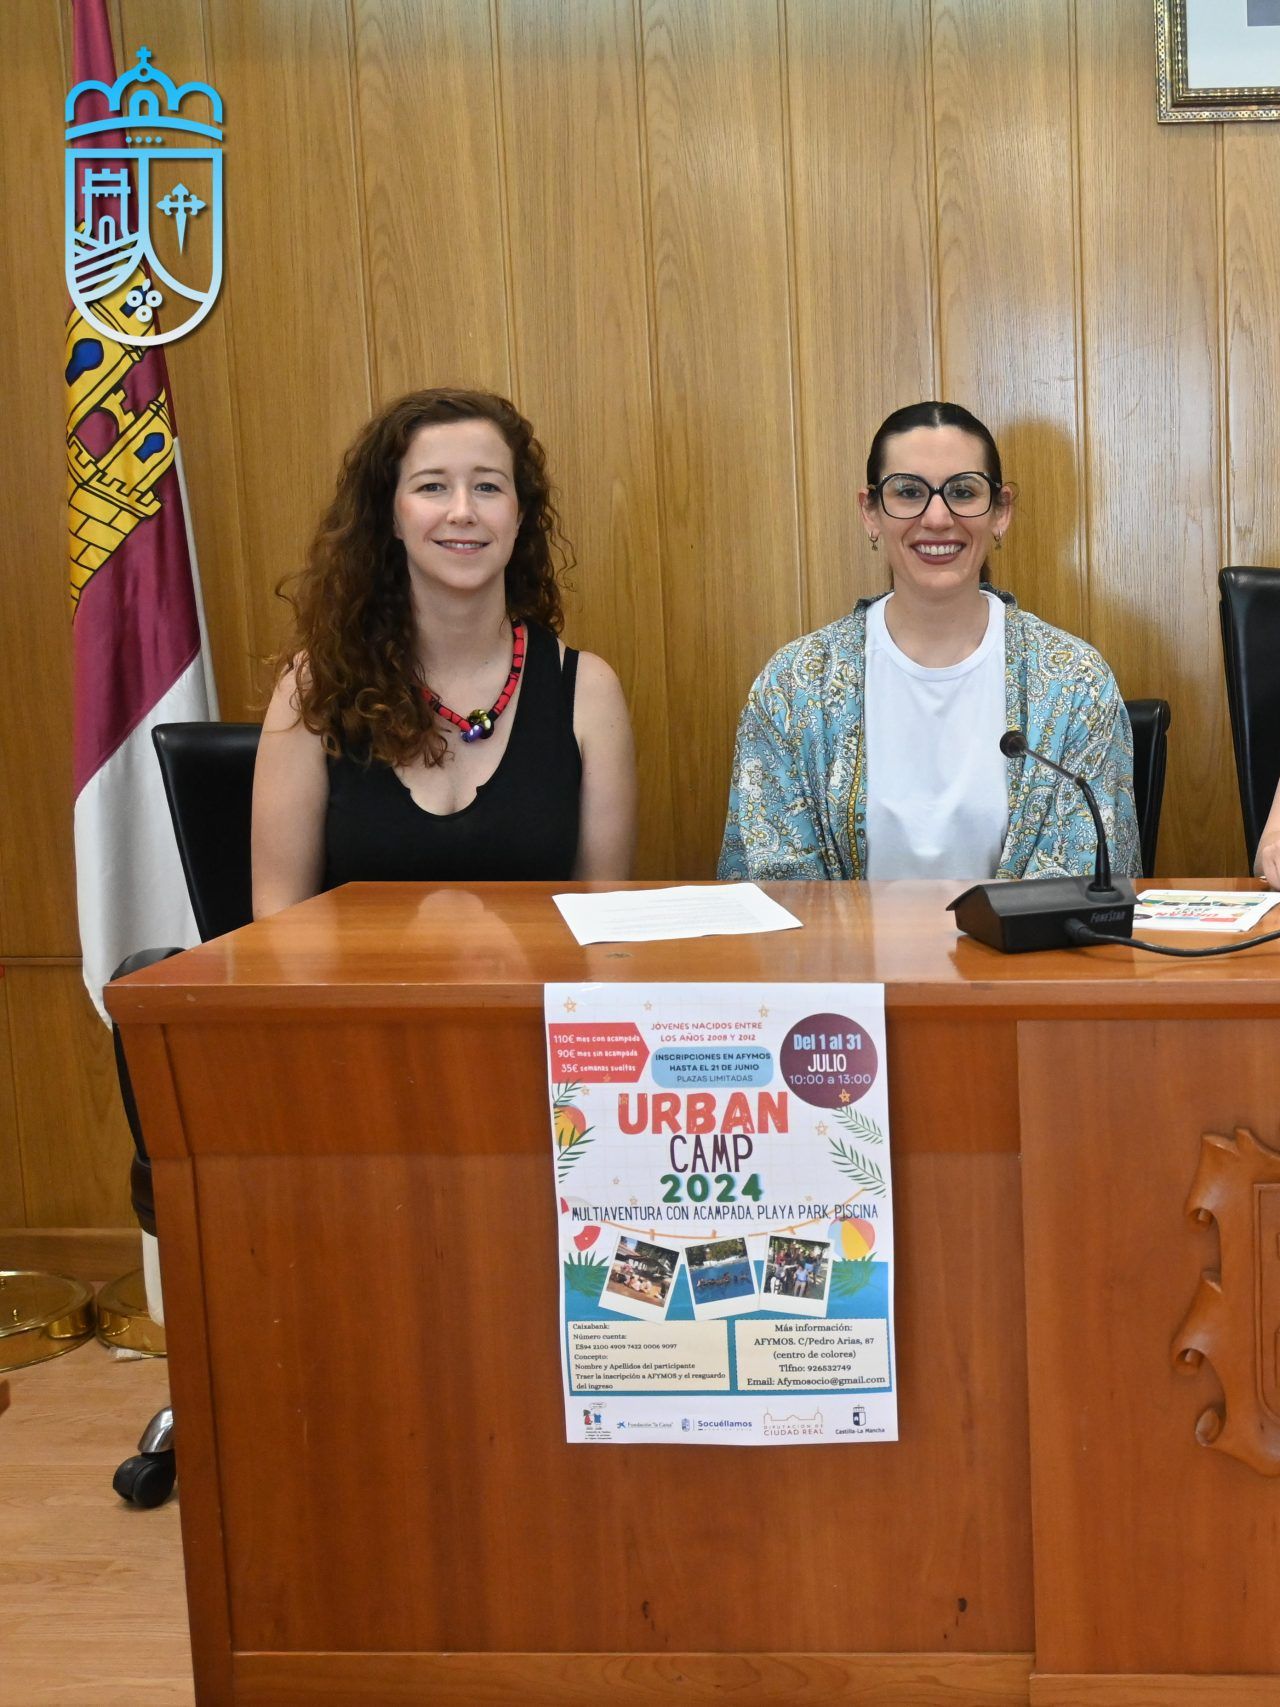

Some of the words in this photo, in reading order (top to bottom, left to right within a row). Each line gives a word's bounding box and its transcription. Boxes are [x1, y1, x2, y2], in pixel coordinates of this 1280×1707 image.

[651, 1022, 689, 1031] JÓVENES
[692, 1022, 732, 1030] NACIDOS
[735, 1022, 763, 1030] ENTRE
[553, 1034, 575, 1044] 110€
[606, 1035, 640, 1044] acampada
[660, 1034, 676, 1042] LOS
[679, 1032, 704, 1042] AÑOS
[794, 1034, 814, 1050] Del
[817, 1035, 825, 1050] 1
[829, 1034, 843, 1050] al
[847, 1035, 861, 1049] 31
[557, 1049, 575, 1059] 90€
[605, 1049, 637, 1058] acampada
[656, 1053, 721, 1061] INSCRIPCIONES
[736, 1052, 771, 1060] AFYMOS
[561, 1064, 578, 1073] 35€
[610, 1064, 636, 1072] sueltas
[734, 1063, 759, 1071] JUNIO
[807, 1054, 846, 1073] JULIO
[710, 1074, 753, 1082] LIMITADAS
[789, 1074, 824, 1085] 10:00
[827, 1077, 833, 1085] a
[839, 1074, 871, 1085] 13:00
[618, 1091, 789, 1135] URBAN
[670, 1134, 753, 1173] CAMP
[660, 1173, 764, 1203] 2024
[572, 1206, 663, 1221] MULTIAVENTURA
[666, 1206, 689, 1221] CON
[758, 1205, 793, 1219] PLAYA
[834, 1205, 877, 1218] PISCINA
[775, 1324, 793, 1332] Más
[795, 1324, 852, 1332] información:
[798, 1338, 835, 1347] C/Pedro
[837, 1337, 862, 1345] Arias,
[773, 1351, 806, 1360] (centro
[821, 1351, 856, 1359] colores)
[807, 1364, 851, 1372] 926532749
[747, 1378, 775, 1386] Email:
[777, 1376, 885, 1387] Afymosocio@gmail.com
[698, 1420, 752, 1428] Socuéllamos
